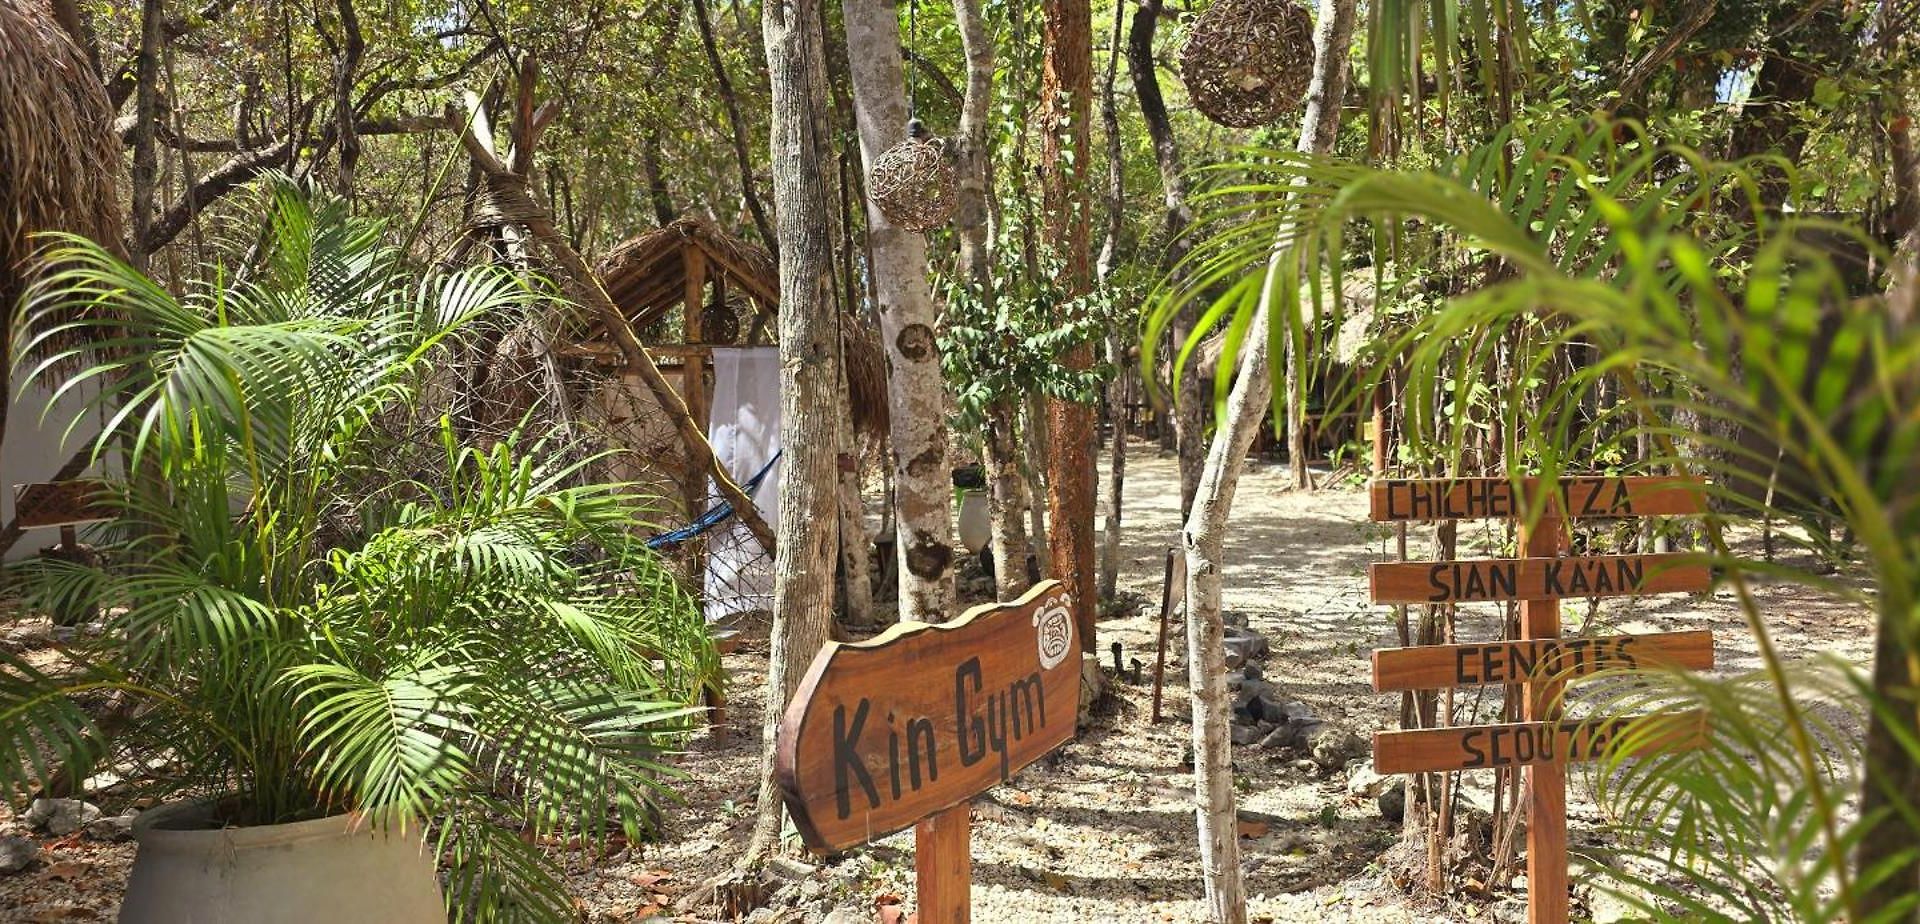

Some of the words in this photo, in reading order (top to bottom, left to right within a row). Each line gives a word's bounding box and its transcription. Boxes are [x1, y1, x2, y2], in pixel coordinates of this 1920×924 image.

[1543, 478, 1632, 514] TZA
[1429, 564, 1516, 601] SIAN
[1545, 559, 1643, 595] KA'AN
[1456, 637, 1637, 684] CENOTES
[833, 698, 938, 820] Kin
[956, 656, 1046, 783] Gym
